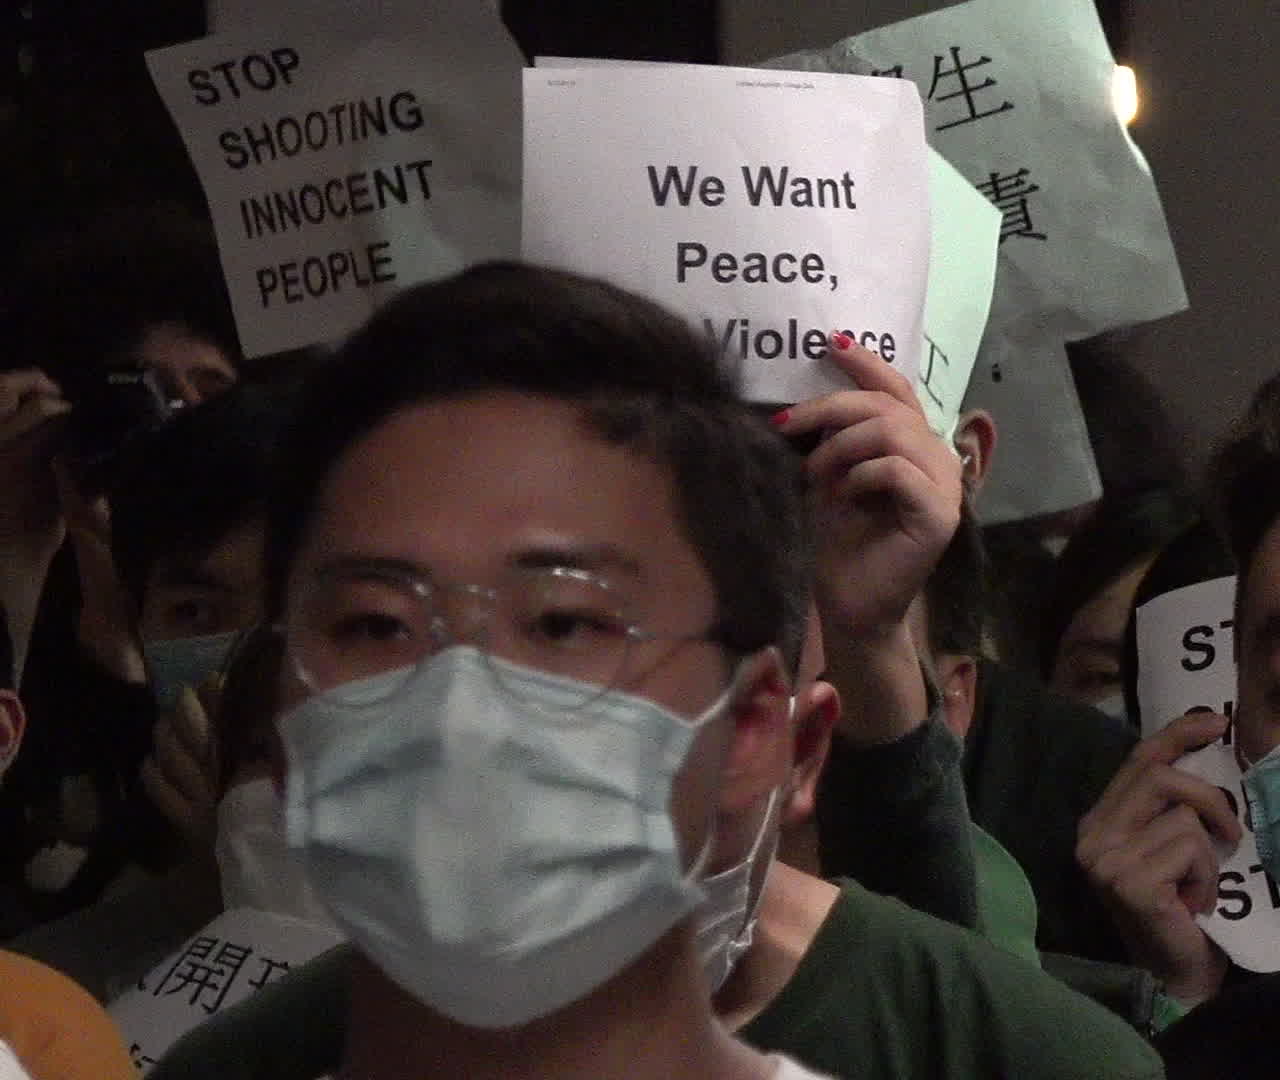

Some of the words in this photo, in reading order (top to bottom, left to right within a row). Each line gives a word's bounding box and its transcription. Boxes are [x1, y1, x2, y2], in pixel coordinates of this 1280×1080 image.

[187, 47, 300, 107] STOP
[218, 91, 424, 170] SHOOTING
[240, 160, 432, 238] INNOCENT
[647, 164, 726, 207] We
[740, 164, 858, 210] Want
[256, 242, 395, 307] PEOPLE
[675, 241, 840, 291] Peace,
